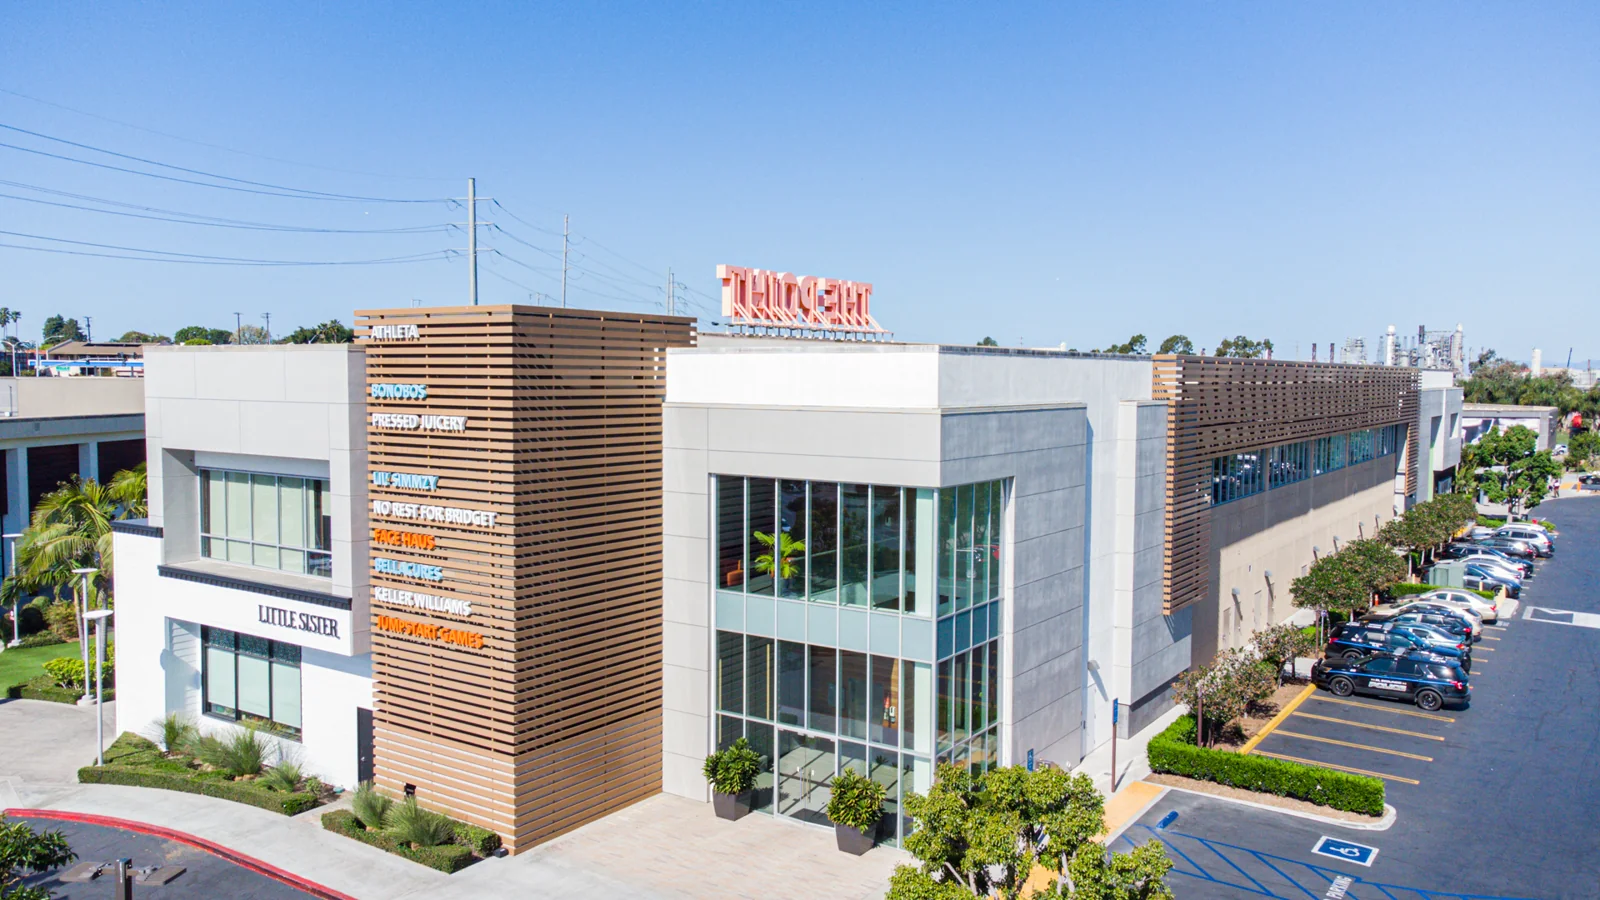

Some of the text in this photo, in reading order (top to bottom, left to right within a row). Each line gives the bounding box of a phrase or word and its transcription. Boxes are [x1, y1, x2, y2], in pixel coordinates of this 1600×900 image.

[371, 324, 420, 339] ATHLETA
[371, 384, 427, 399] BONOBOS
[372, 413, 468, 430] PRESSED JUICERY
[392, 473, 439, 490] SIMMZY
[373, 500, 497, 527] NO REST FOR BRIDGET
[374, 528, 436, 550] FACE HAUS
[374, 558, 443, 581] BELLACURES
[374, 587, 472, 616] KELLER WILLIAMS
[258, 604, 341, 640] LITTLE SISTER
[377, 615, 484, 649] JUMPSTART GAMES
